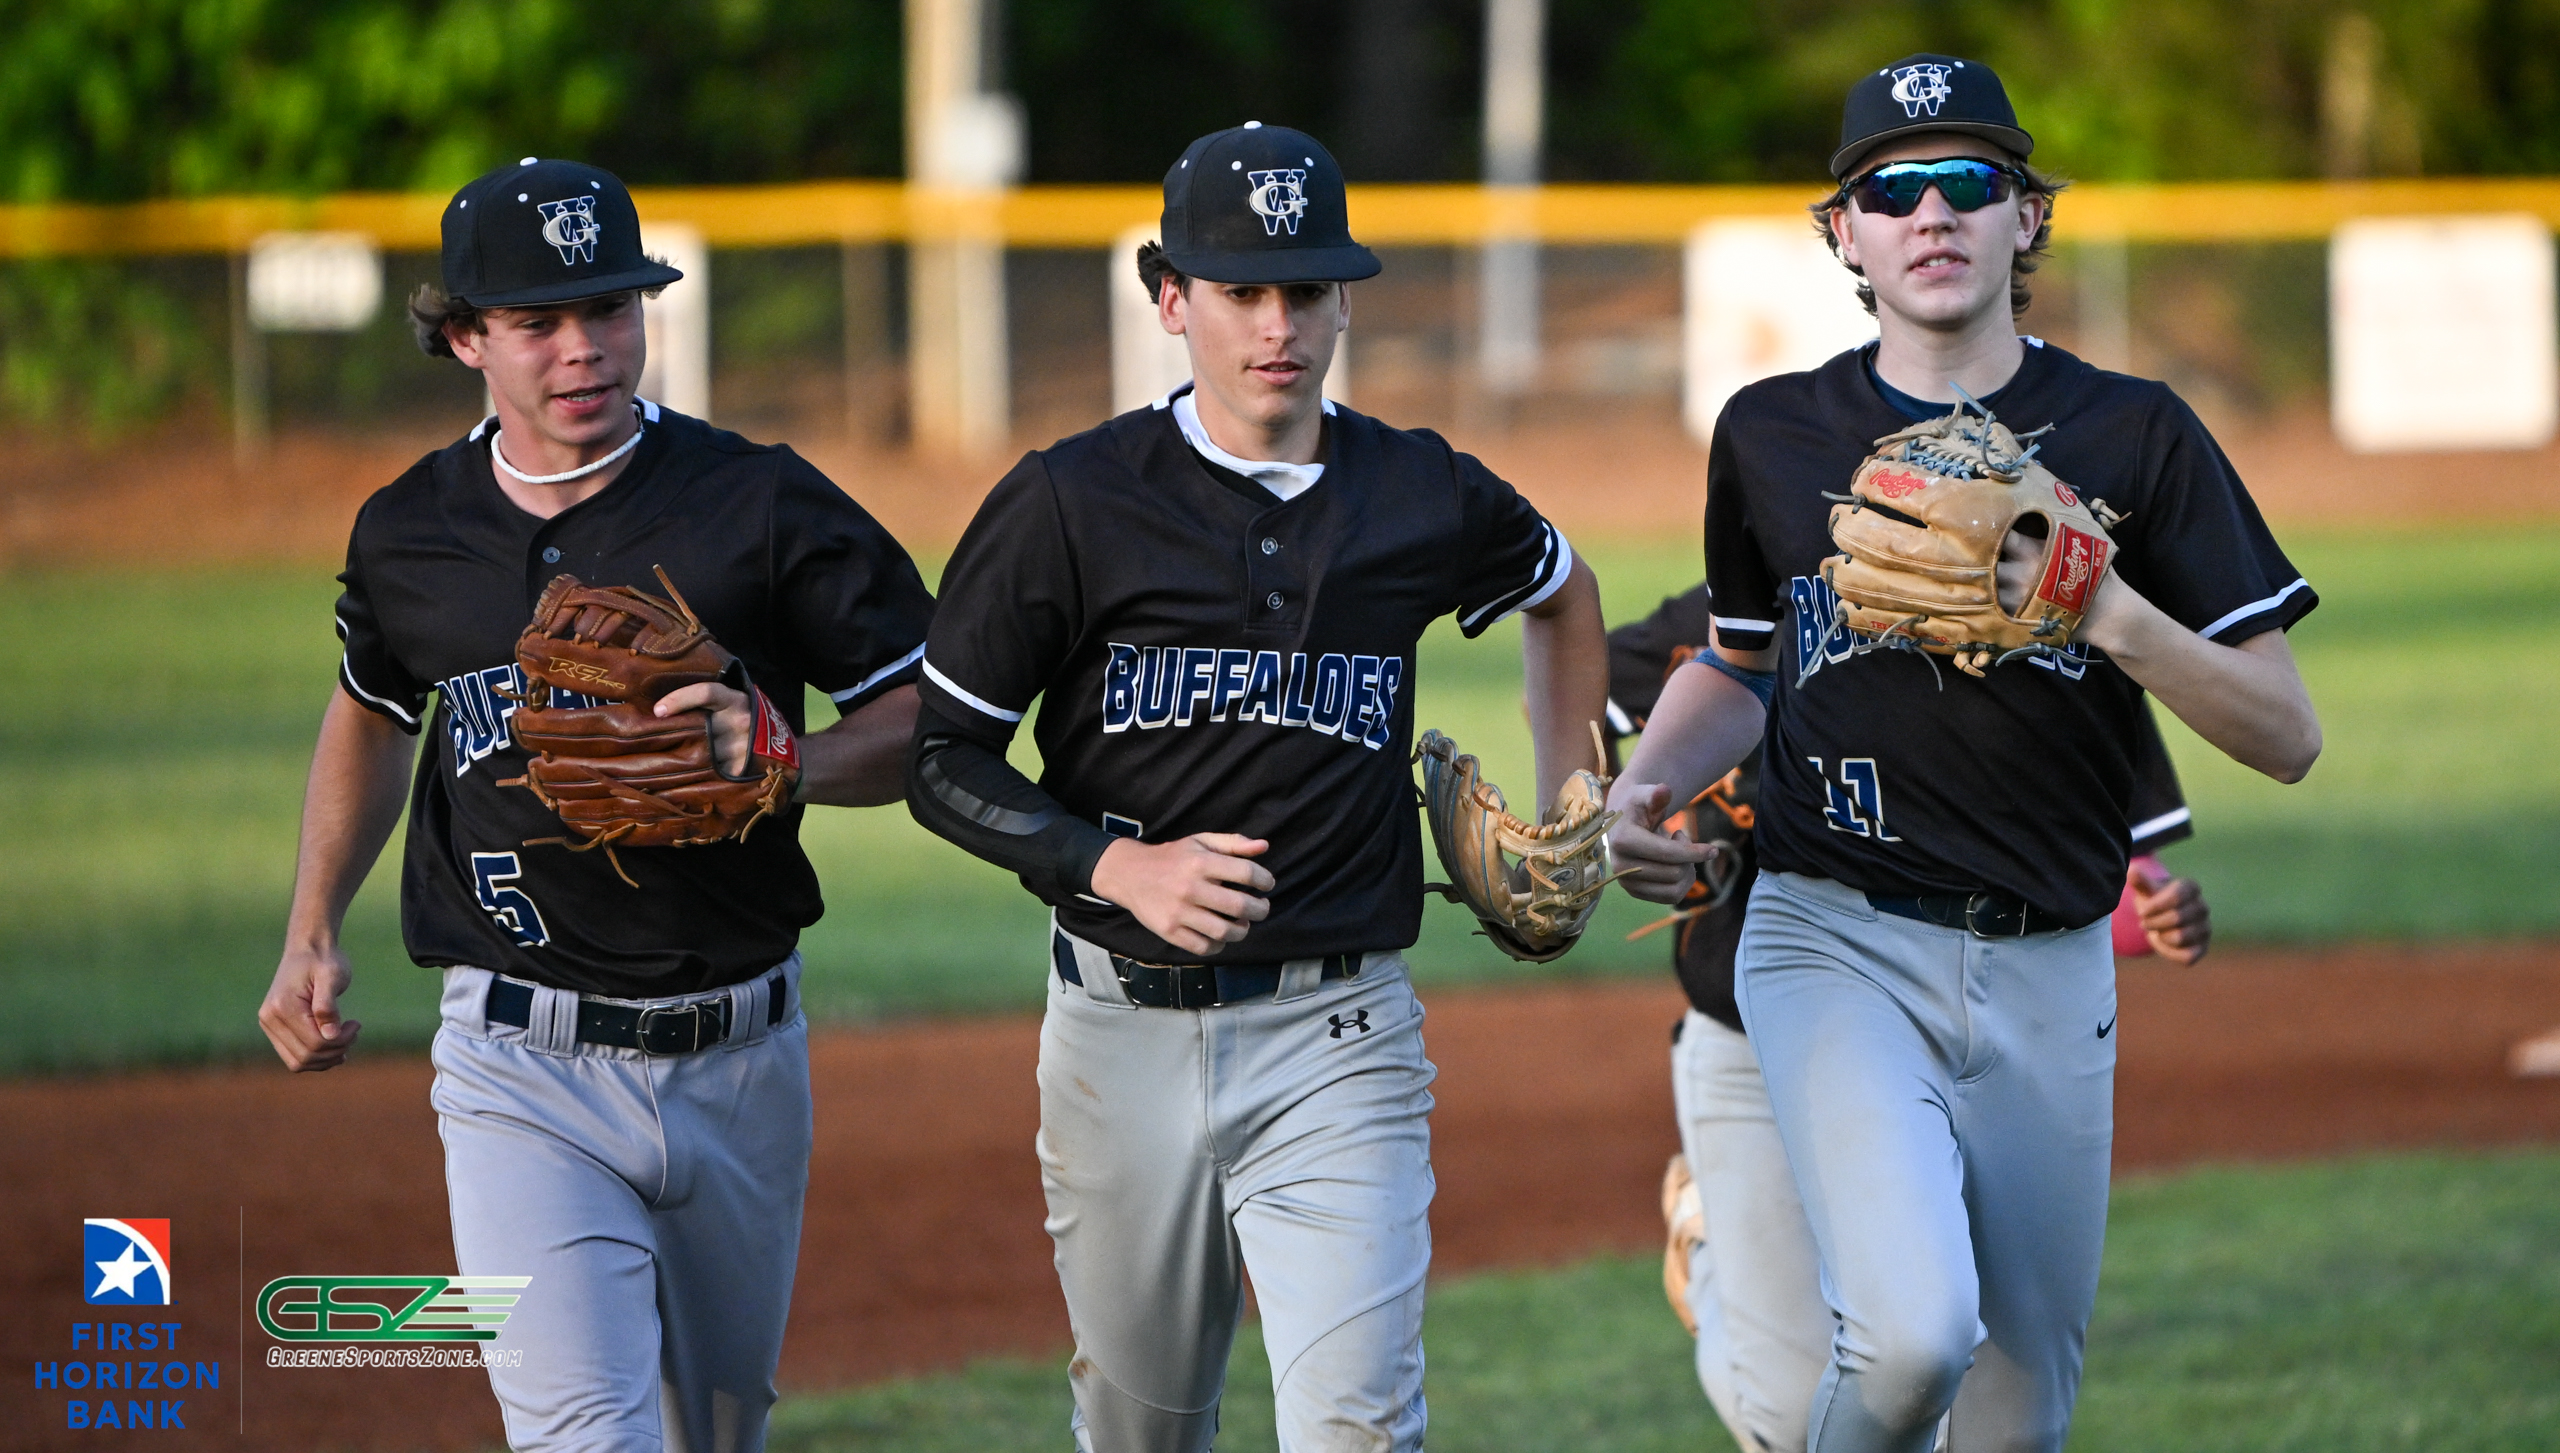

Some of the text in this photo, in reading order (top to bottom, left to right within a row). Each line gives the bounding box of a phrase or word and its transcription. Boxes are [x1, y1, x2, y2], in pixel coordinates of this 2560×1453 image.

[2058, 535, 2089, 601] Rawlings
[1103, 642, 1402, 751] BUFFALOES
[1806, 756, 1903, 842] 11
[470, 850, 551, 948] 5
